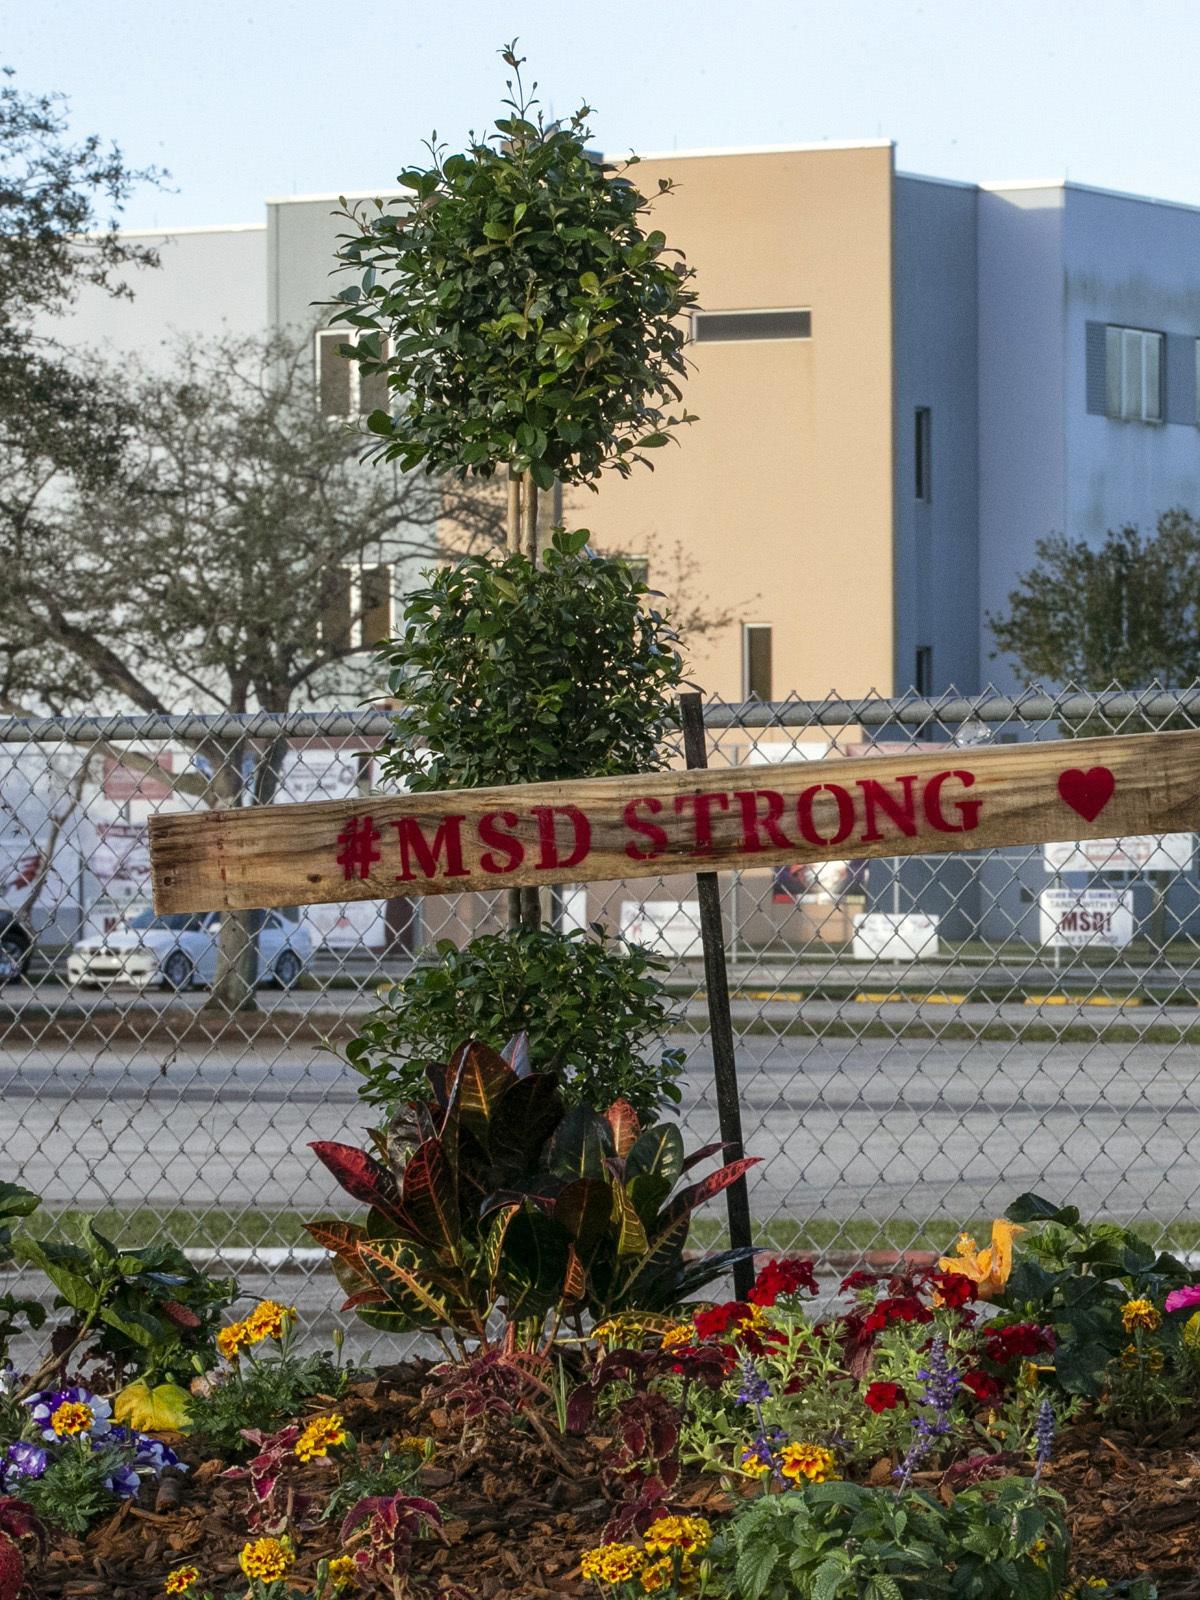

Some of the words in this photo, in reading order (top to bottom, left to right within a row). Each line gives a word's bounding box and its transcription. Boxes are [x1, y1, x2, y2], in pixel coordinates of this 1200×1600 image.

[336, 803, 593, 881] #MSD
[624, 769, 984, 861] STRONG
[1061, 911, 1111, 932] MSD!
